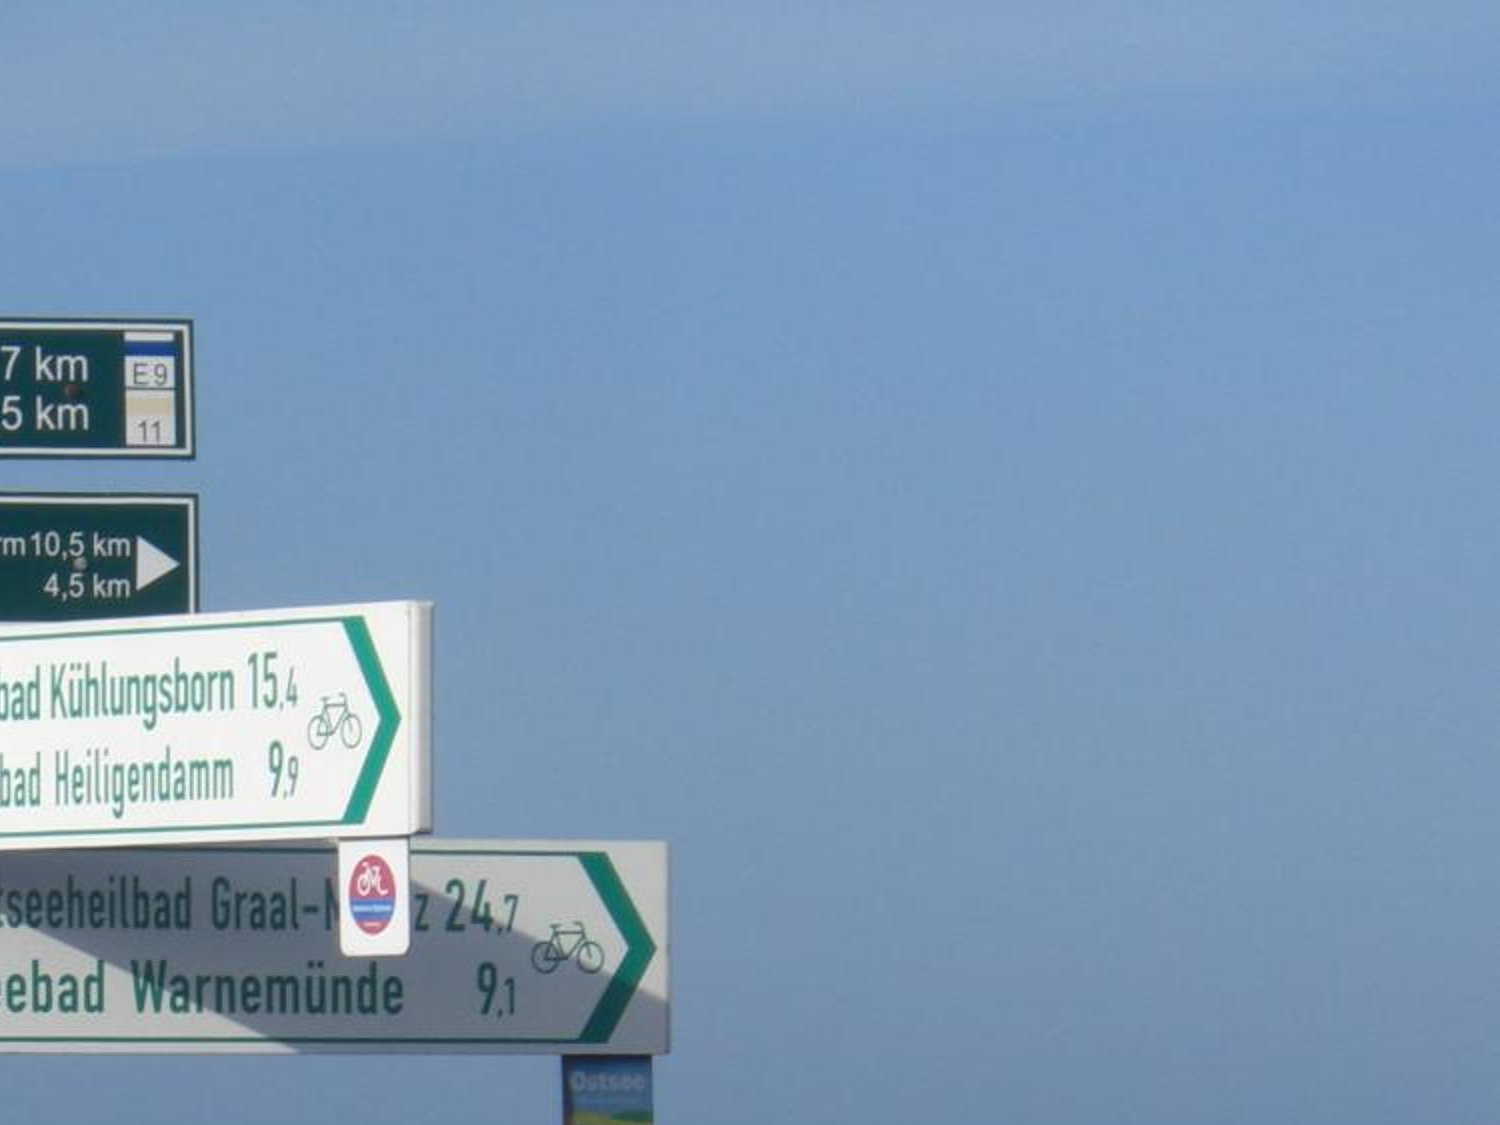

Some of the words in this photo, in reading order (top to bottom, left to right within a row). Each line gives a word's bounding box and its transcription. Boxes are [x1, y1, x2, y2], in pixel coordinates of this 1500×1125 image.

[0, 345, 21, 381] 7
[35, 346, 89, 382] km
[35, 396, 90, 431] km
[137, 420, 162, 443] 11
[30, 531, 85, 561] 10,5
[93, 532, 131, 557] km
[43, 573, 85, 601] 4,5
[93, 575, 131, 599] km
[50, 656, 235, 731] Kühlungsborn
[248, 651, 298, 711] 15,4
[55, 744, 235, 819] Heiligendamm
[268, 740, 299, 801] 9,9
[445, 878, 520, 935] 24,7
[130, 961, 404, 1015] Warnemünde
[478, 962, 516, 1019] 9,1
